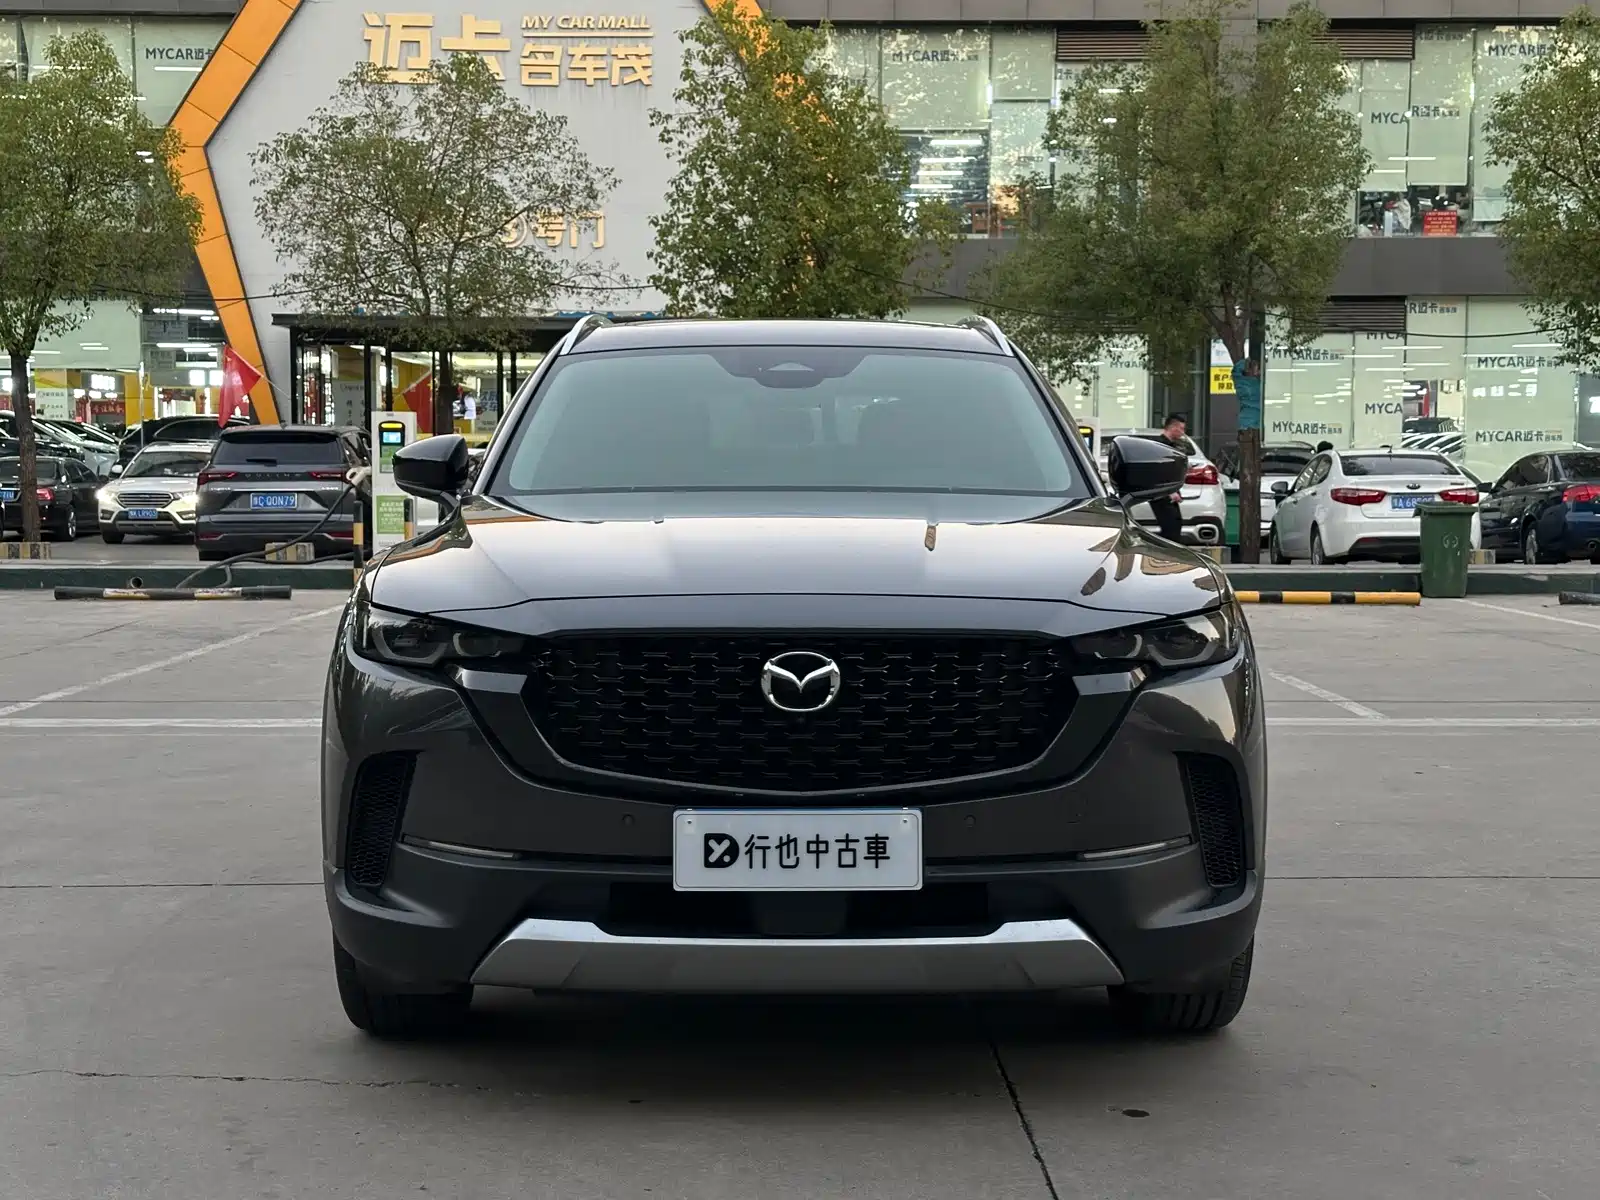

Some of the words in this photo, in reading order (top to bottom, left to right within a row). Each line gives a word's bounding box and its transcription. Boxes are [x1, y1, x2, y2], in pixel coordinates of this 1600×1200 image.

[521, 15, 552, 29] MY
[556, 15, 594, 29] CAR
[598, 15, 650, 29] MALL
[361, 12, 511, 84] 迈卡
[520, 42, 653, 86] 名车茂
[744, 833, 891, 869] 行也中古車
